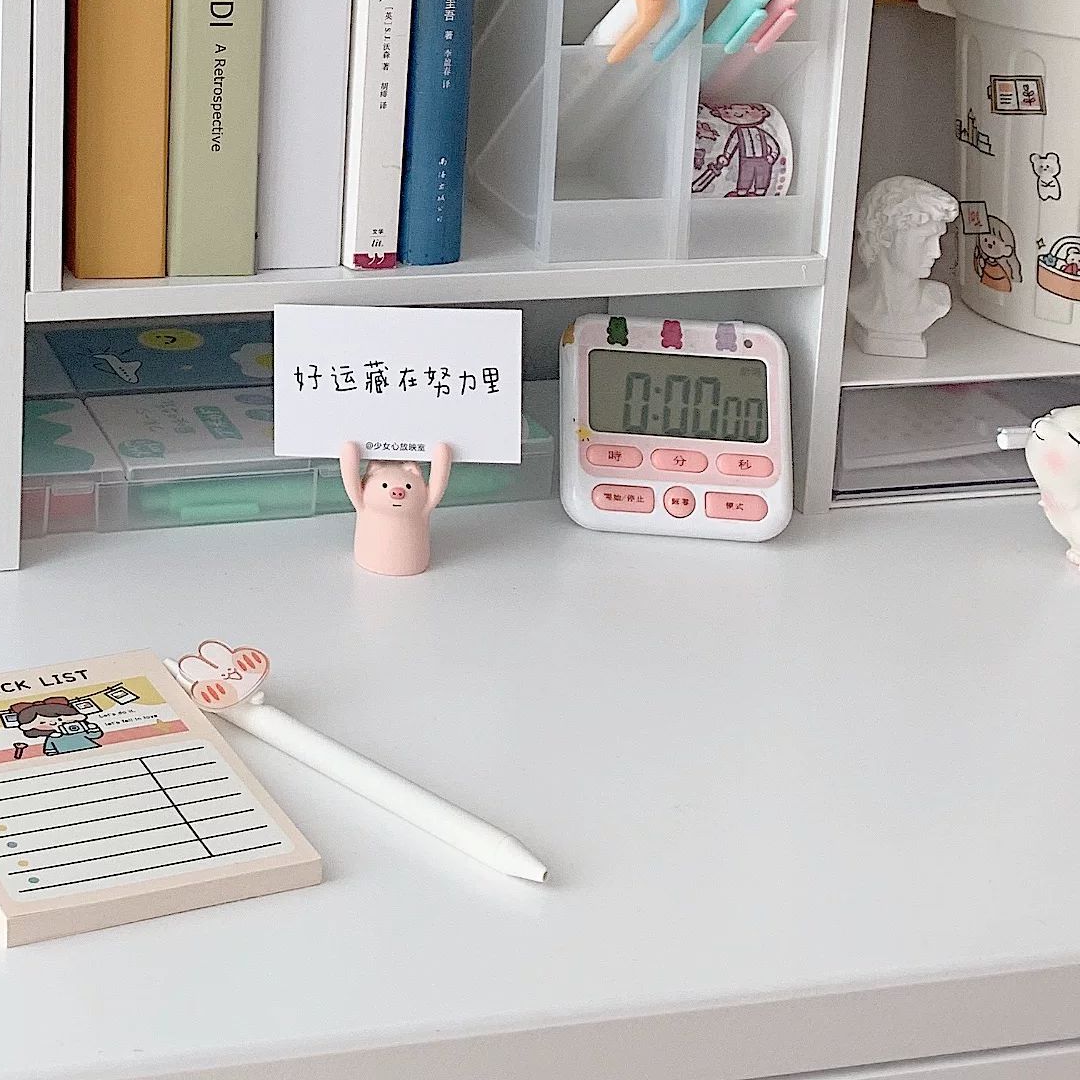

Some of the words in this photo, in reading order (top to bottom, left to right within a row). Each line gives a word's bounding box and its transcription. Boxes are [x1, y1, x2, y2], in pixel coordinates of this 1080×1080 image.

[215, 43, 227, 54] A
[210, 58, 227, 153] Retrospective
[293, 360, 500, 398] 好运藏在努力里
[608, 450, 622, 462] 時
[673, 454, 687, 466] 分
[737, 459, 752, 470] 秒
[38, 668, 90, 688] LIST
